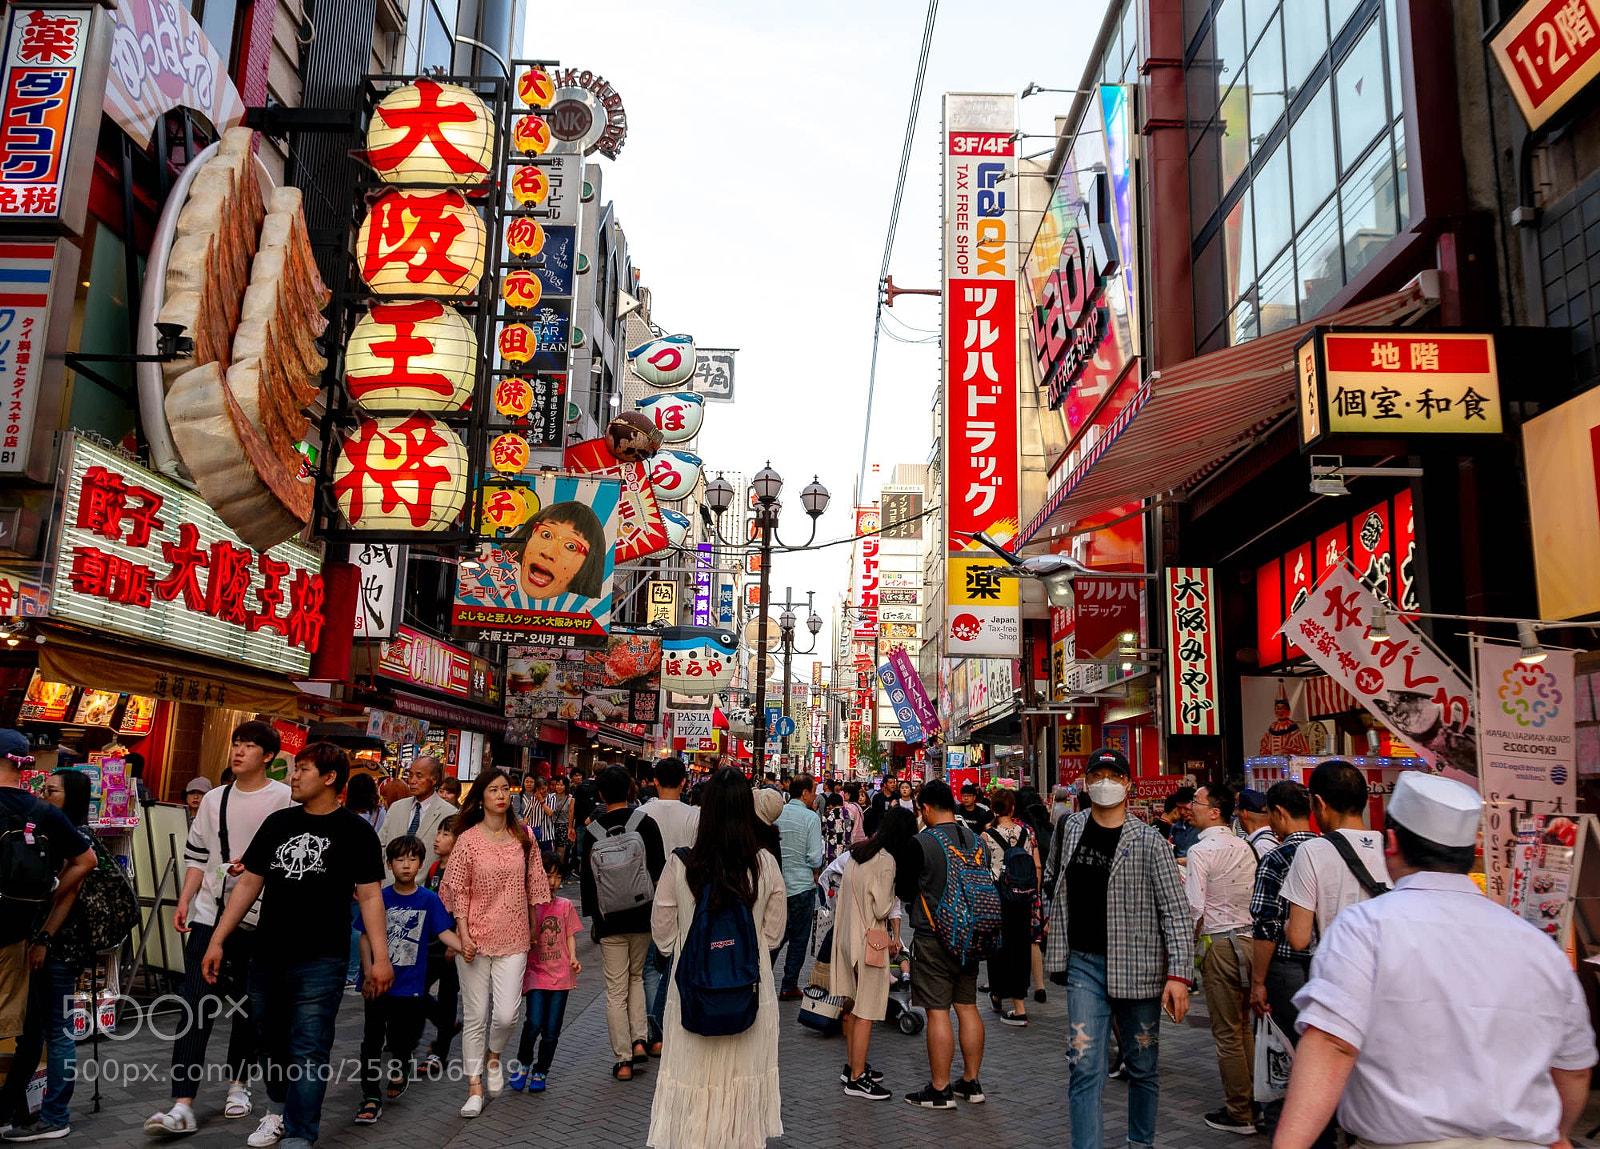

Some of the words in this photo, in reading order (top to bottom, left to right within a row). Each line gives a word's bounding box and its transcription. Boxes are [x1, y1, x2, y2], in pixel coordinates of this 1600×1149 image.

[16, 10, 82, 64] 薬
[555, 68, 610, 97] IKOH
[1, 71, 68, 180] ダイコク
[555, 113, 582, 131] NK
[953, 137, 1009, 153] 3F/4F
[957, 163, 969, 190] TAX
[0, 187, 57, 214] 免税
[957, 194, 969, 231] FREE
[977, 163, 1006, 277] Laox
[957, 235, 969, 275] SHOP
[332, 77, 494, 527] 大阪王将
[487, 70, 547, 522] 大阪名物元祖焼餃子
[533, 327, 559, 335] BAR
[534, 343, 567, 351] CEAN
[1057, 341, 1077, 387] FREE
[1076, 307, 1098, 360] SHOP
[1371, 342, 1440, 370] 地階
[4, 317, 34, 447] タイ料理とタイスキの店
[963, 290, 1003, 516] ツルハドラッグ
[1332, 386, 1491, 421] 個室・和食
[1, 452, 15, 464] B1
[461, 550, 518, 565] しもと
[461, 567, 518, 581] エンタメ
[966, 565, 1000, 599] 薬
[154, 523, 325, 653] 大阪王将
[458, 583, 517, 600] ショップ
[1077, 582, 1137, 600] ツルハ
[457, 610, 592, 629] よしもと芸人グッズ・大阪みやげ
[991, 616, 1017, 624] Japan.
[1077, 604, 1126, 617] ドラッグ
[999, 633, 1017, 641] Shop
[1174, 577, 1212, 726] 大阪みやげ
[666, 659, 722, 677] ぼらや
[905, 678, 932, 719] ZAZA
[678, 713, 711, 721] PASTA
[678, 727, 710, 735] PIZZA
[1063, 730, 1081, 752] 薬
[1139, 778, 1167, 786] Welcome
